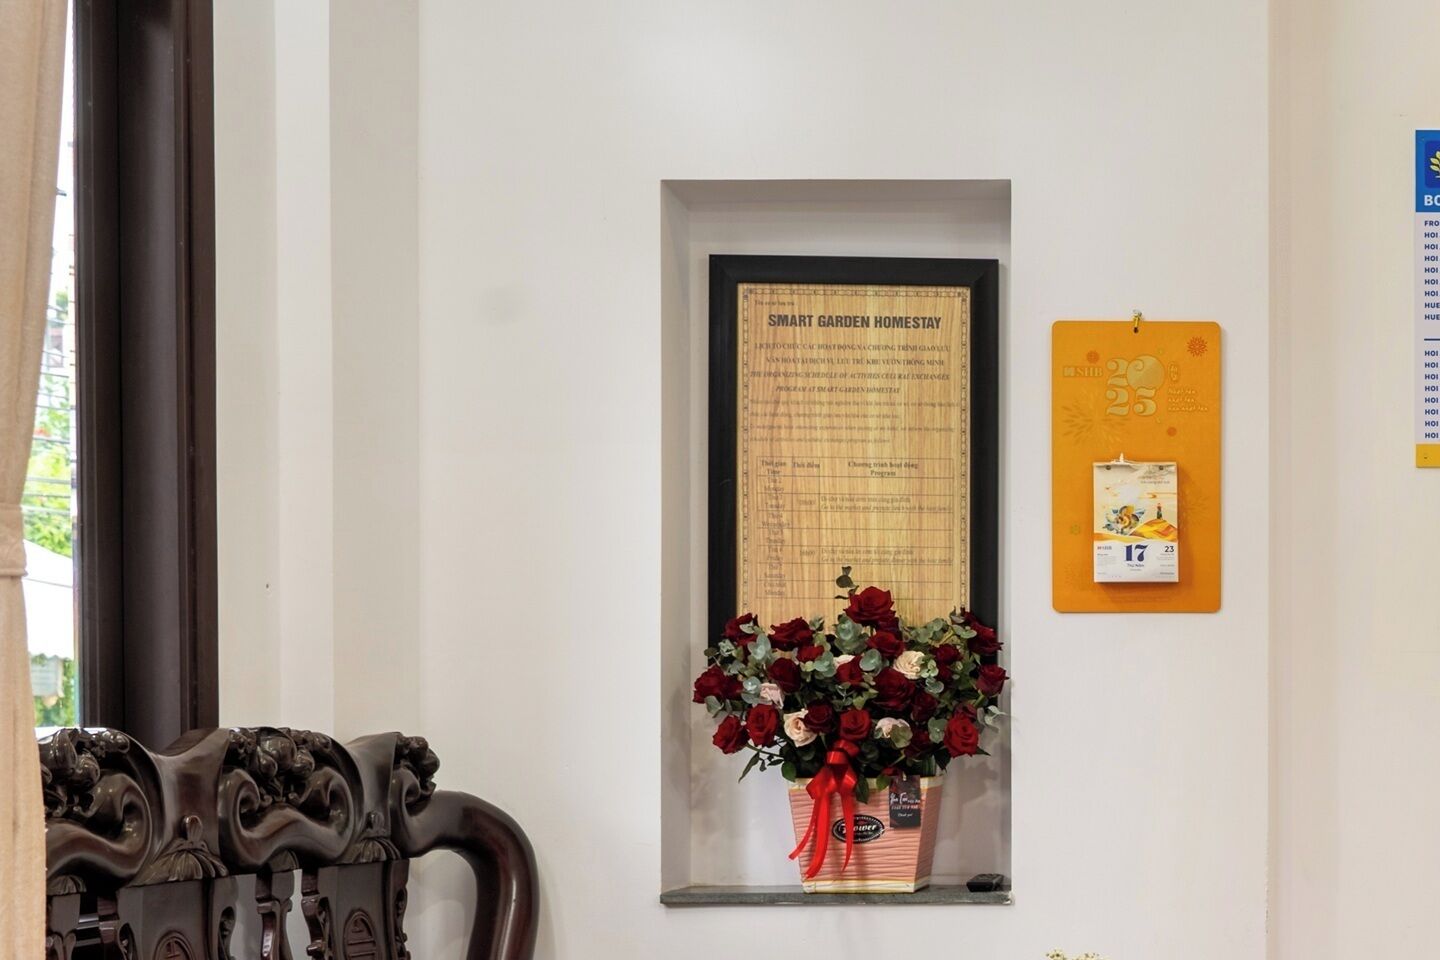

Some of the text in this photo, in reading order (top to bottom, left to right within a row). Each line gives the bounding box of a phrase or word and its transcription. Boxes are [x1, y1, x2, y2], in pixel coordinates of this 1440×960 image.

[1423, 231, 1439, 239] HOI
[1424, 266, 1439, 274] HOI
[1424, 278, 1439, 286] HOI
[1424, 313, 1440, 321] HUE
[768, 314, 942, 330] SMART GARDEN HOMESTAY
[1124, 544, 1149, 562] 17
[1164, 545, 1175, 553] 23
